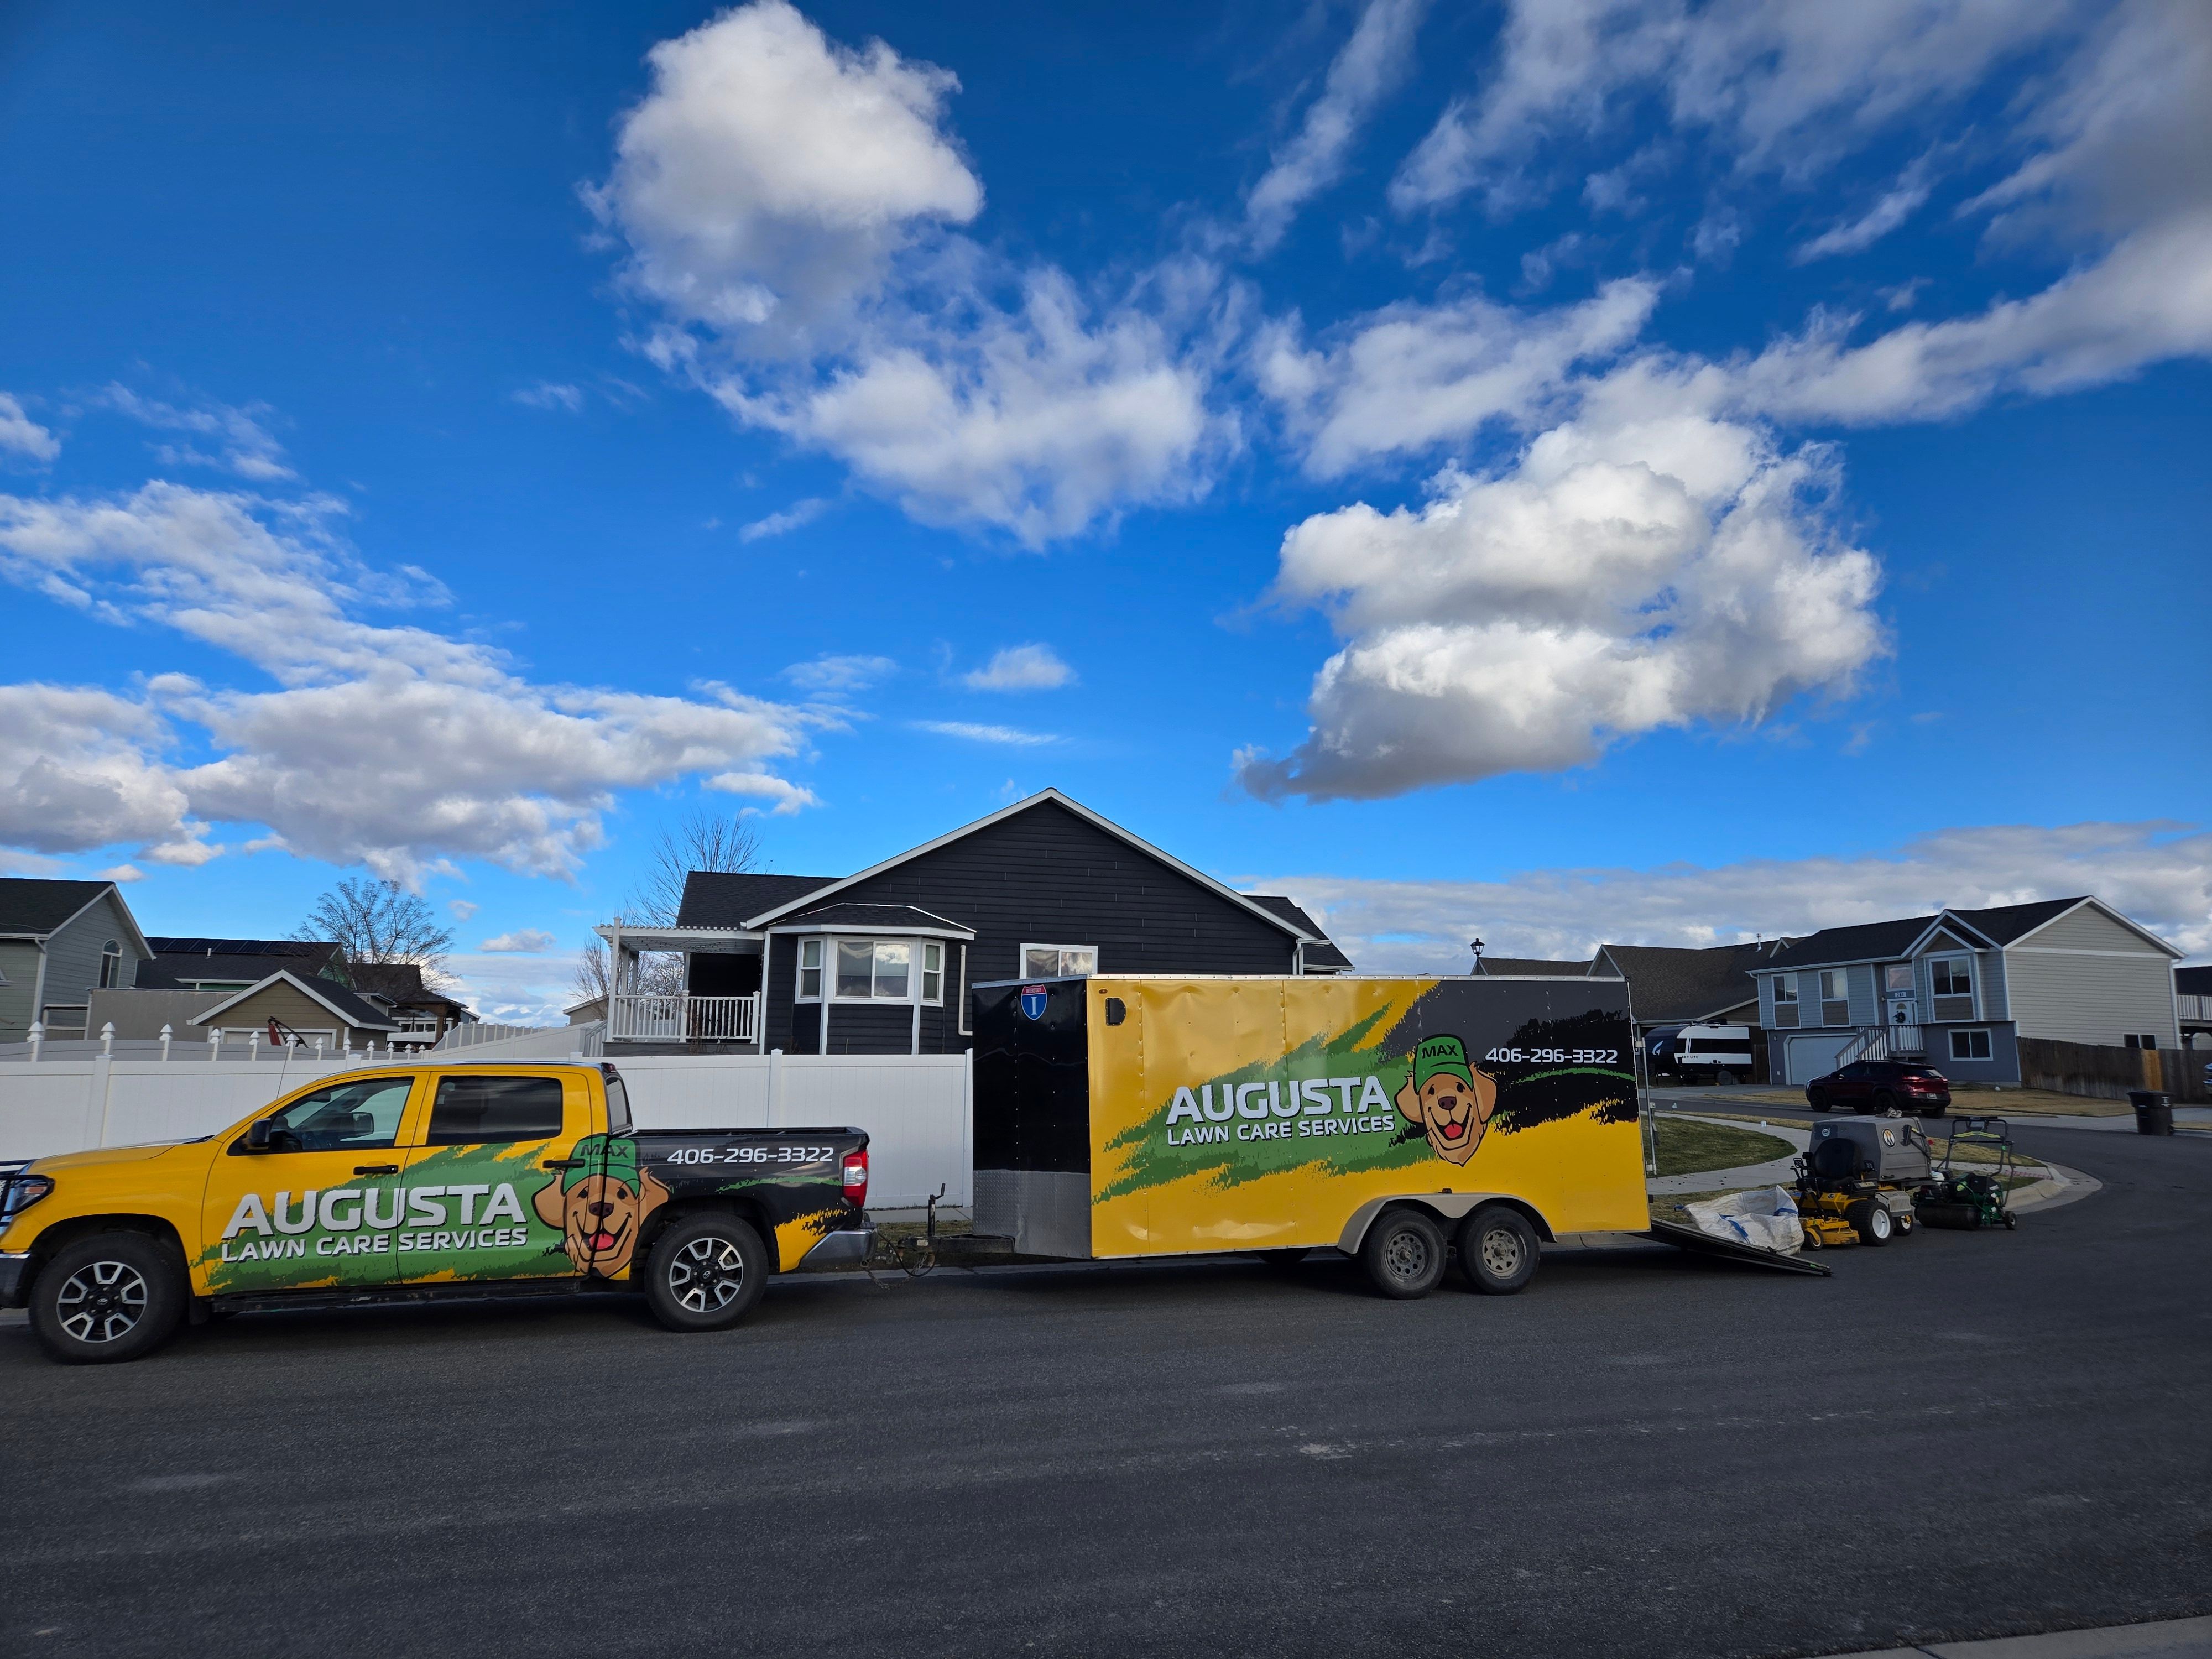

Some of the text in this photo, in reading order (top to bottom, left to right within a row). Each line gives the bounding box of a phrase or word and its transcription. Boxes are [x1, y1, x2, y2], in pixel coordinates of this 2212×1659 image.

[1031, 996, 1037, 1015] I
[1421, 1044, 1459, 1059] MAX
[1485, 1048, 1618, 1063] 406-296-3322
[1166, 1076, 1394, 1125] AUGUSTA
[1167, 1115, 1395, 1146] LAWN CARE SERVICES
[580, 1144, 629, 1158] MAX
[667, 1147, 834, 1164] 406-296-3322
[222, 1183, 527, 1239] AUGUSTA
[222, 1228, 528, 1262] LAWN CARE SERVICES
